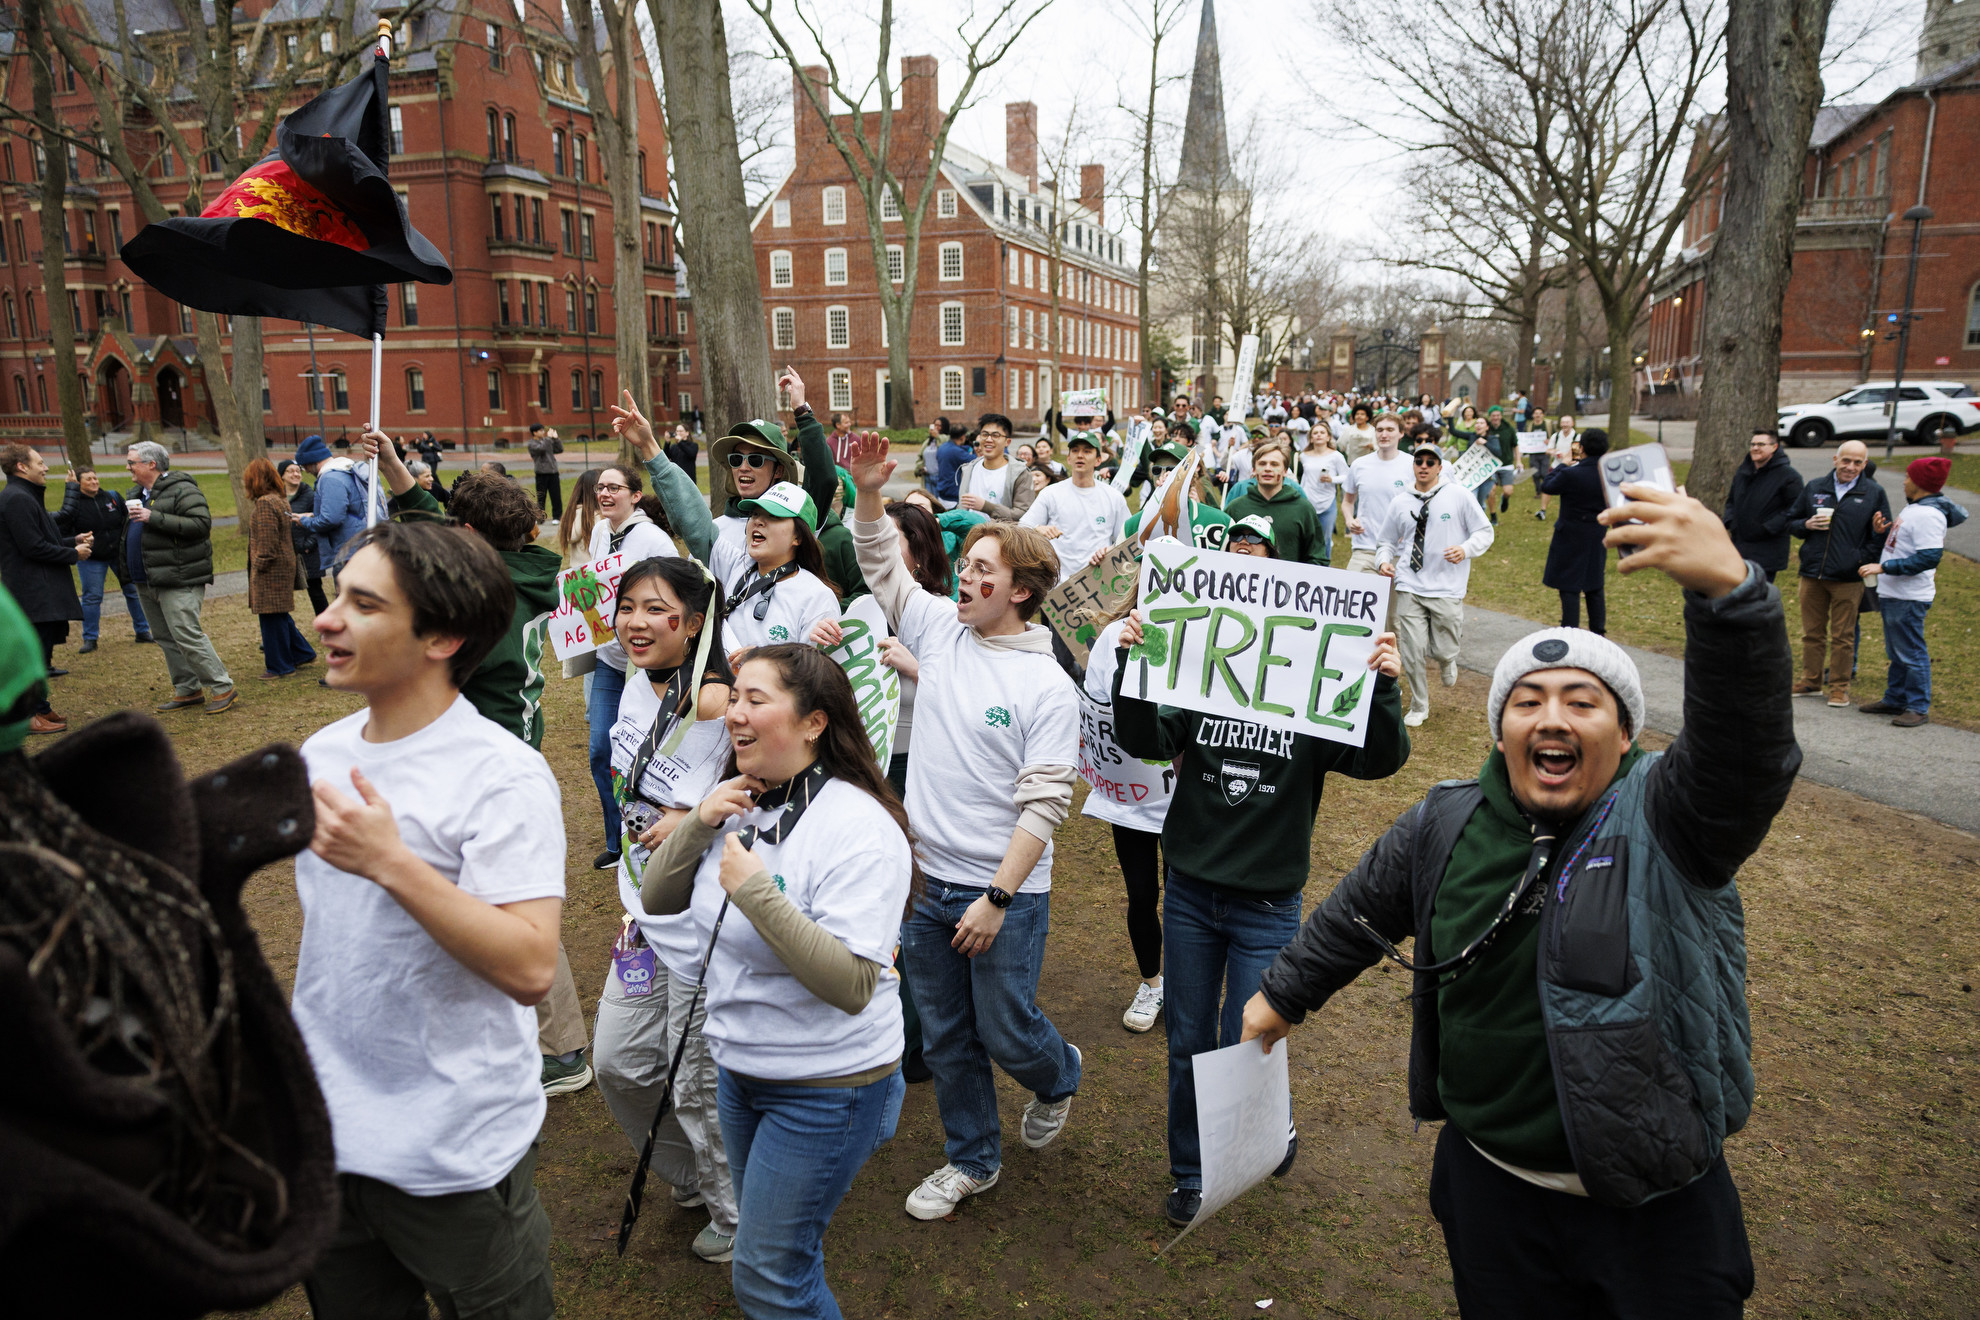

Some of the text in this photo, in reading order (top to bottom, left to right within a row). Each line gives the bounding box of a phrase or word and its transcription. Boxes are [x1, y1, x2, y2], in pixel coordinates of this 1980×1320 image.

[565, 564, 588, 584] ME
[595, 554, 623, 573] GET
[1050, 575, 1090, 613] LET
[1111, 541, 1141, 573] ME
[1148, 567, 1186, 594] NO
[1193, 569, 1260, 604] PLACE
[1262, 575, 1293, 608] I'D
[1295, 581, 1378, 622] RATHER
[565, 613, 617, 648] AGAI
[1149, 606, 1373, 733] TREE
[1196, 717, 1295, 760] CURRIER
[1078, 753, 1149, 803] CHOPPED
[1202, 772, 1217, 784] EST.
[1258, 784, 1276, 794] 1970
